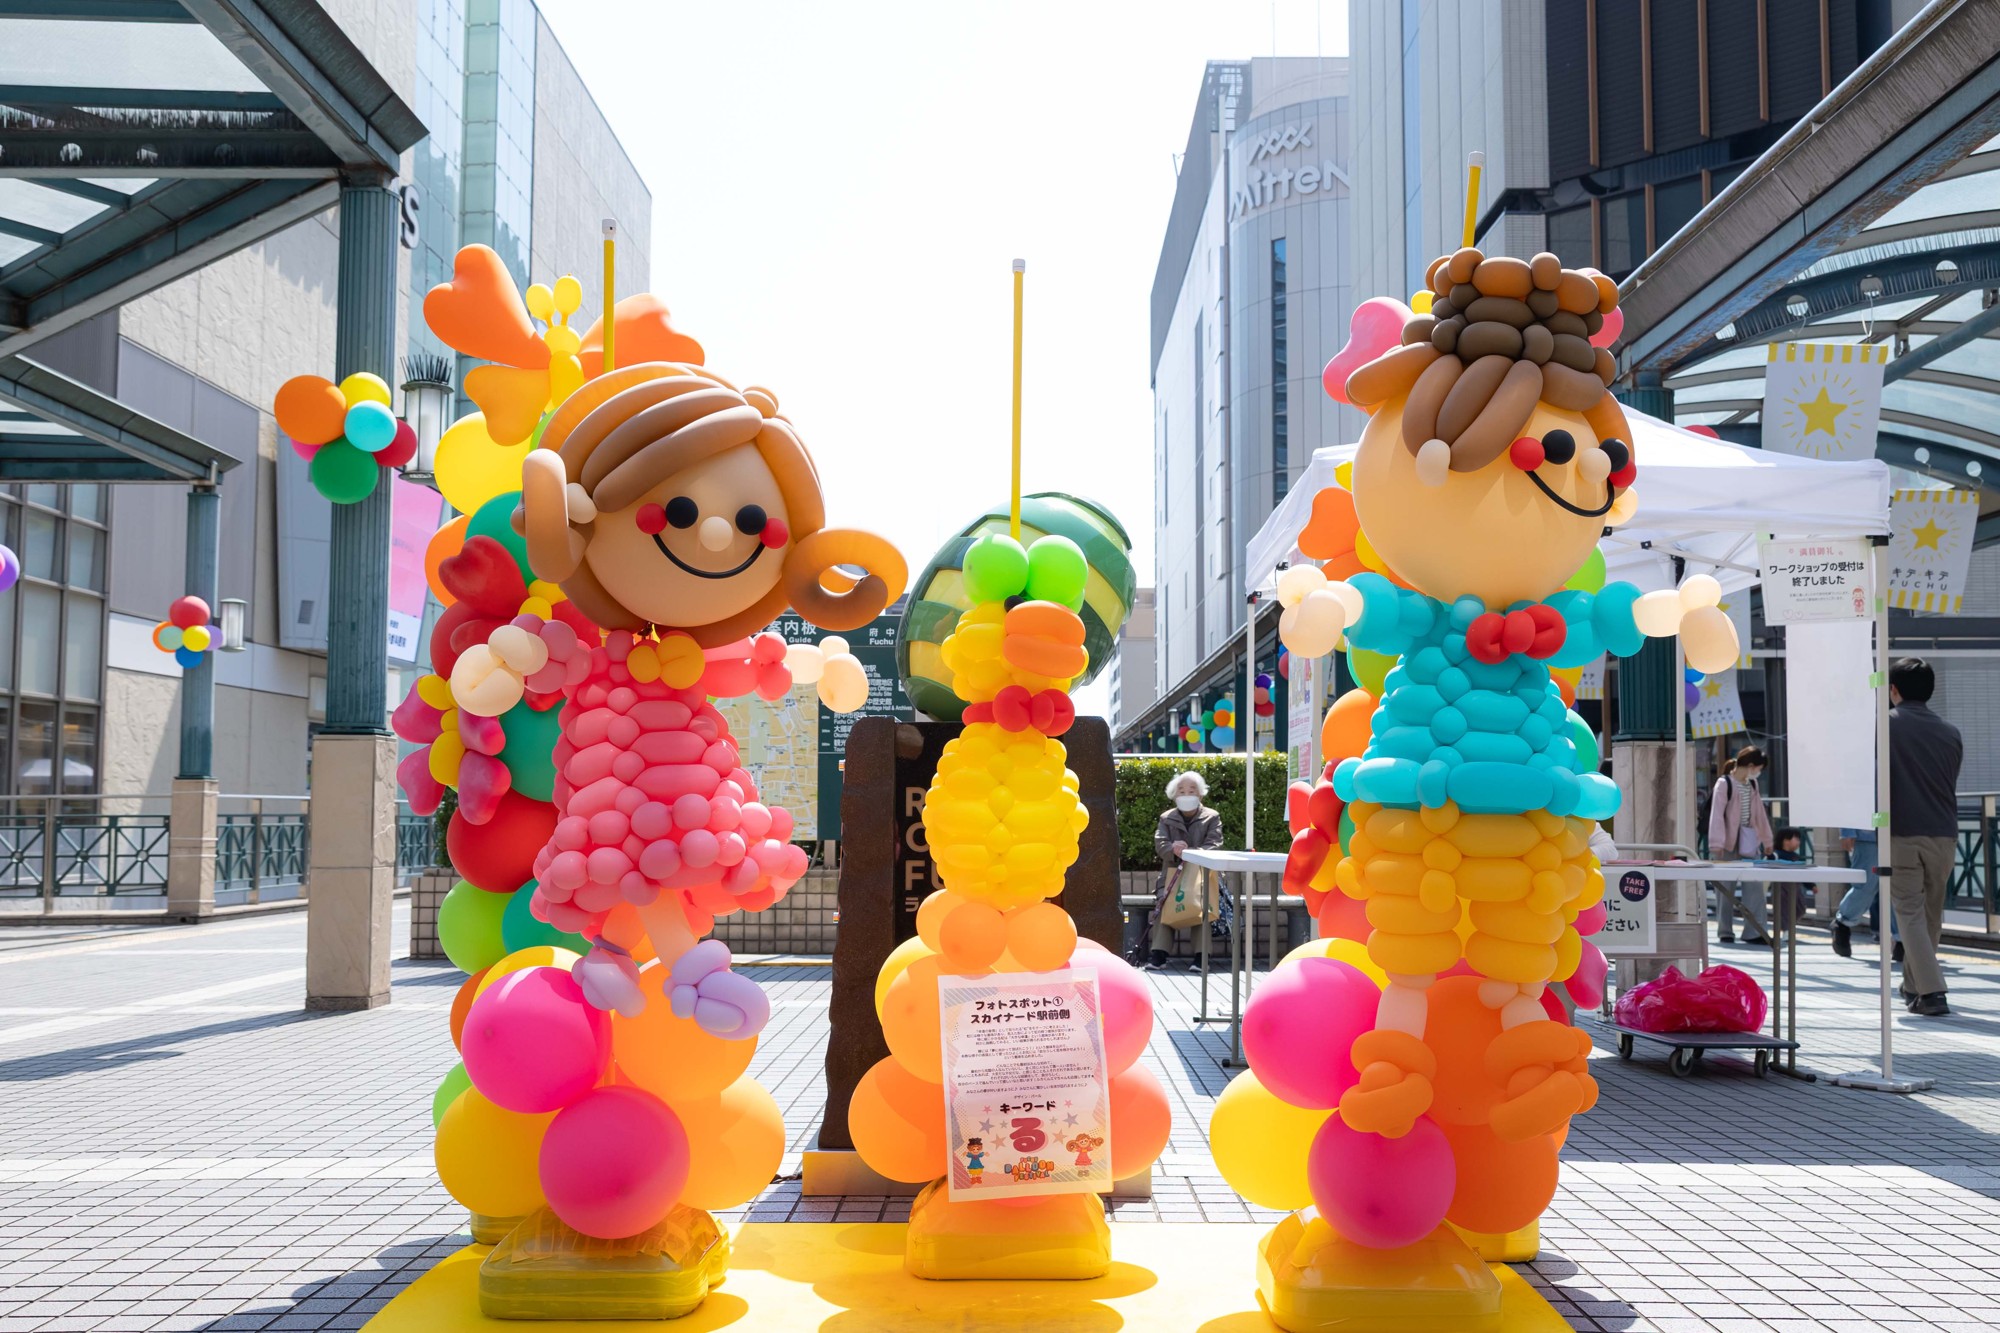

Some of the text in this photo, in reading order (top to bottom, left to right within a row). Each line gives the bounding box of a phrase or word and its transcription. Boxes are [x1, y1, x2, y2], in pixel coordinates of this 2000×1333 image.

[1769, 561, 1864, 575] ワークショップの受付は
[1792, 575, 1845, 587] 終了しました
[1889, 579, 1947, 591] FUCHU
[869, 637, 894, 645] Fuchu
[1625, 877, 1645, 887] TAKE
[1623, 886, 1644, 896] FREE
[975, 996, 1064, 1011] フォトスポット①
[970, 1008, 1070, 1024] スカイナード駅前側
[1000, 1100, 1056, 1114] キーワード
[1009, 1117, 1048, 1153] る
[1004, 1159, 1055, 1176] BALLOON
